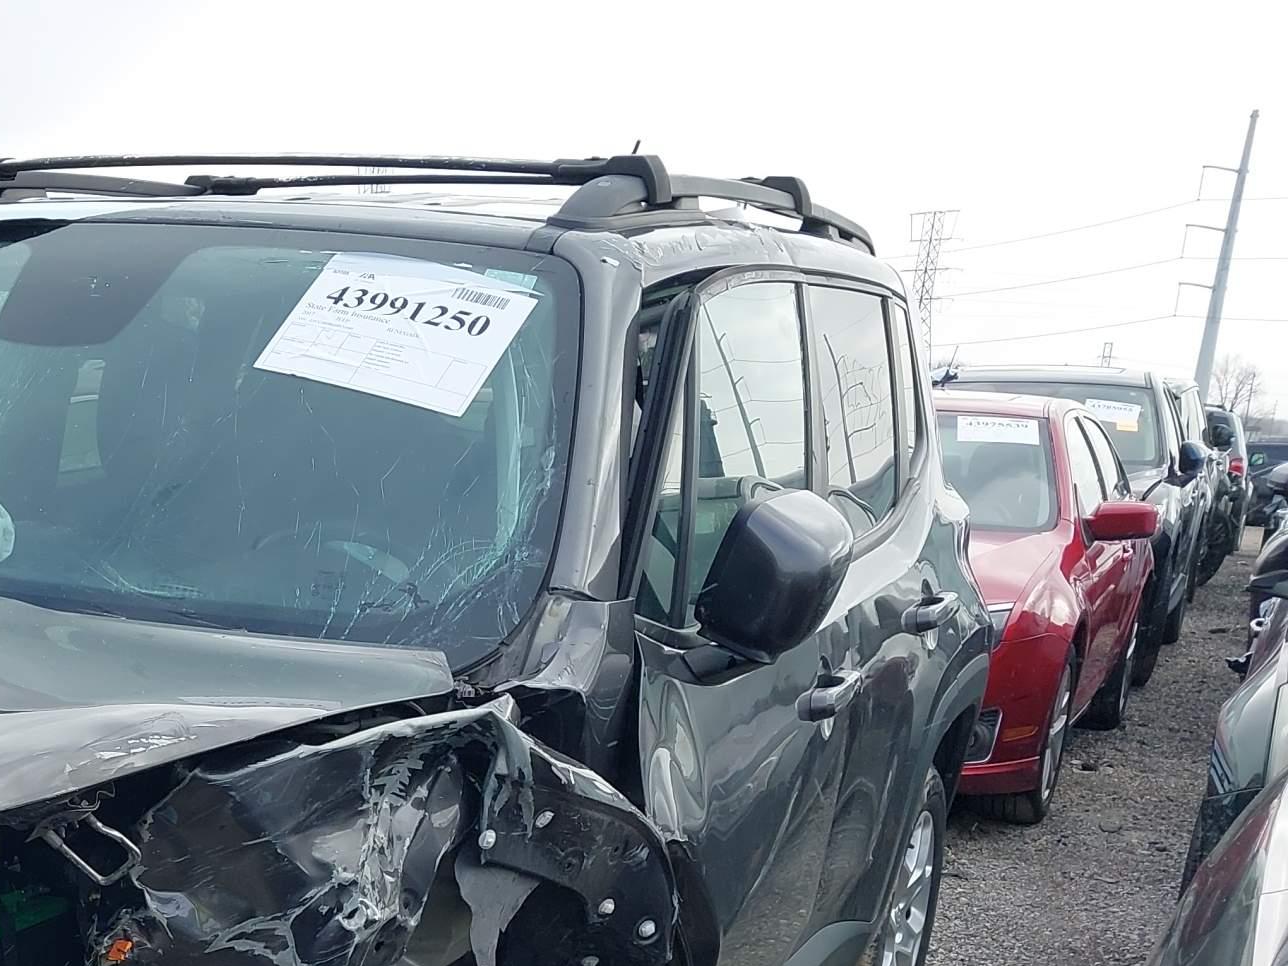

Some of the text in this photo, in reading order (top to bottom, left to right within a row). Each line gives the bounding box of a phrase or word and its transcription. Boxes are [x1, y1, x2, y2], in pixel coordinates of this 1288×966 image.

[326, 286, 491, 337] 43991250
[328, 306, 350, 317] Farm
[351, 310, 391, 324] Insurance
